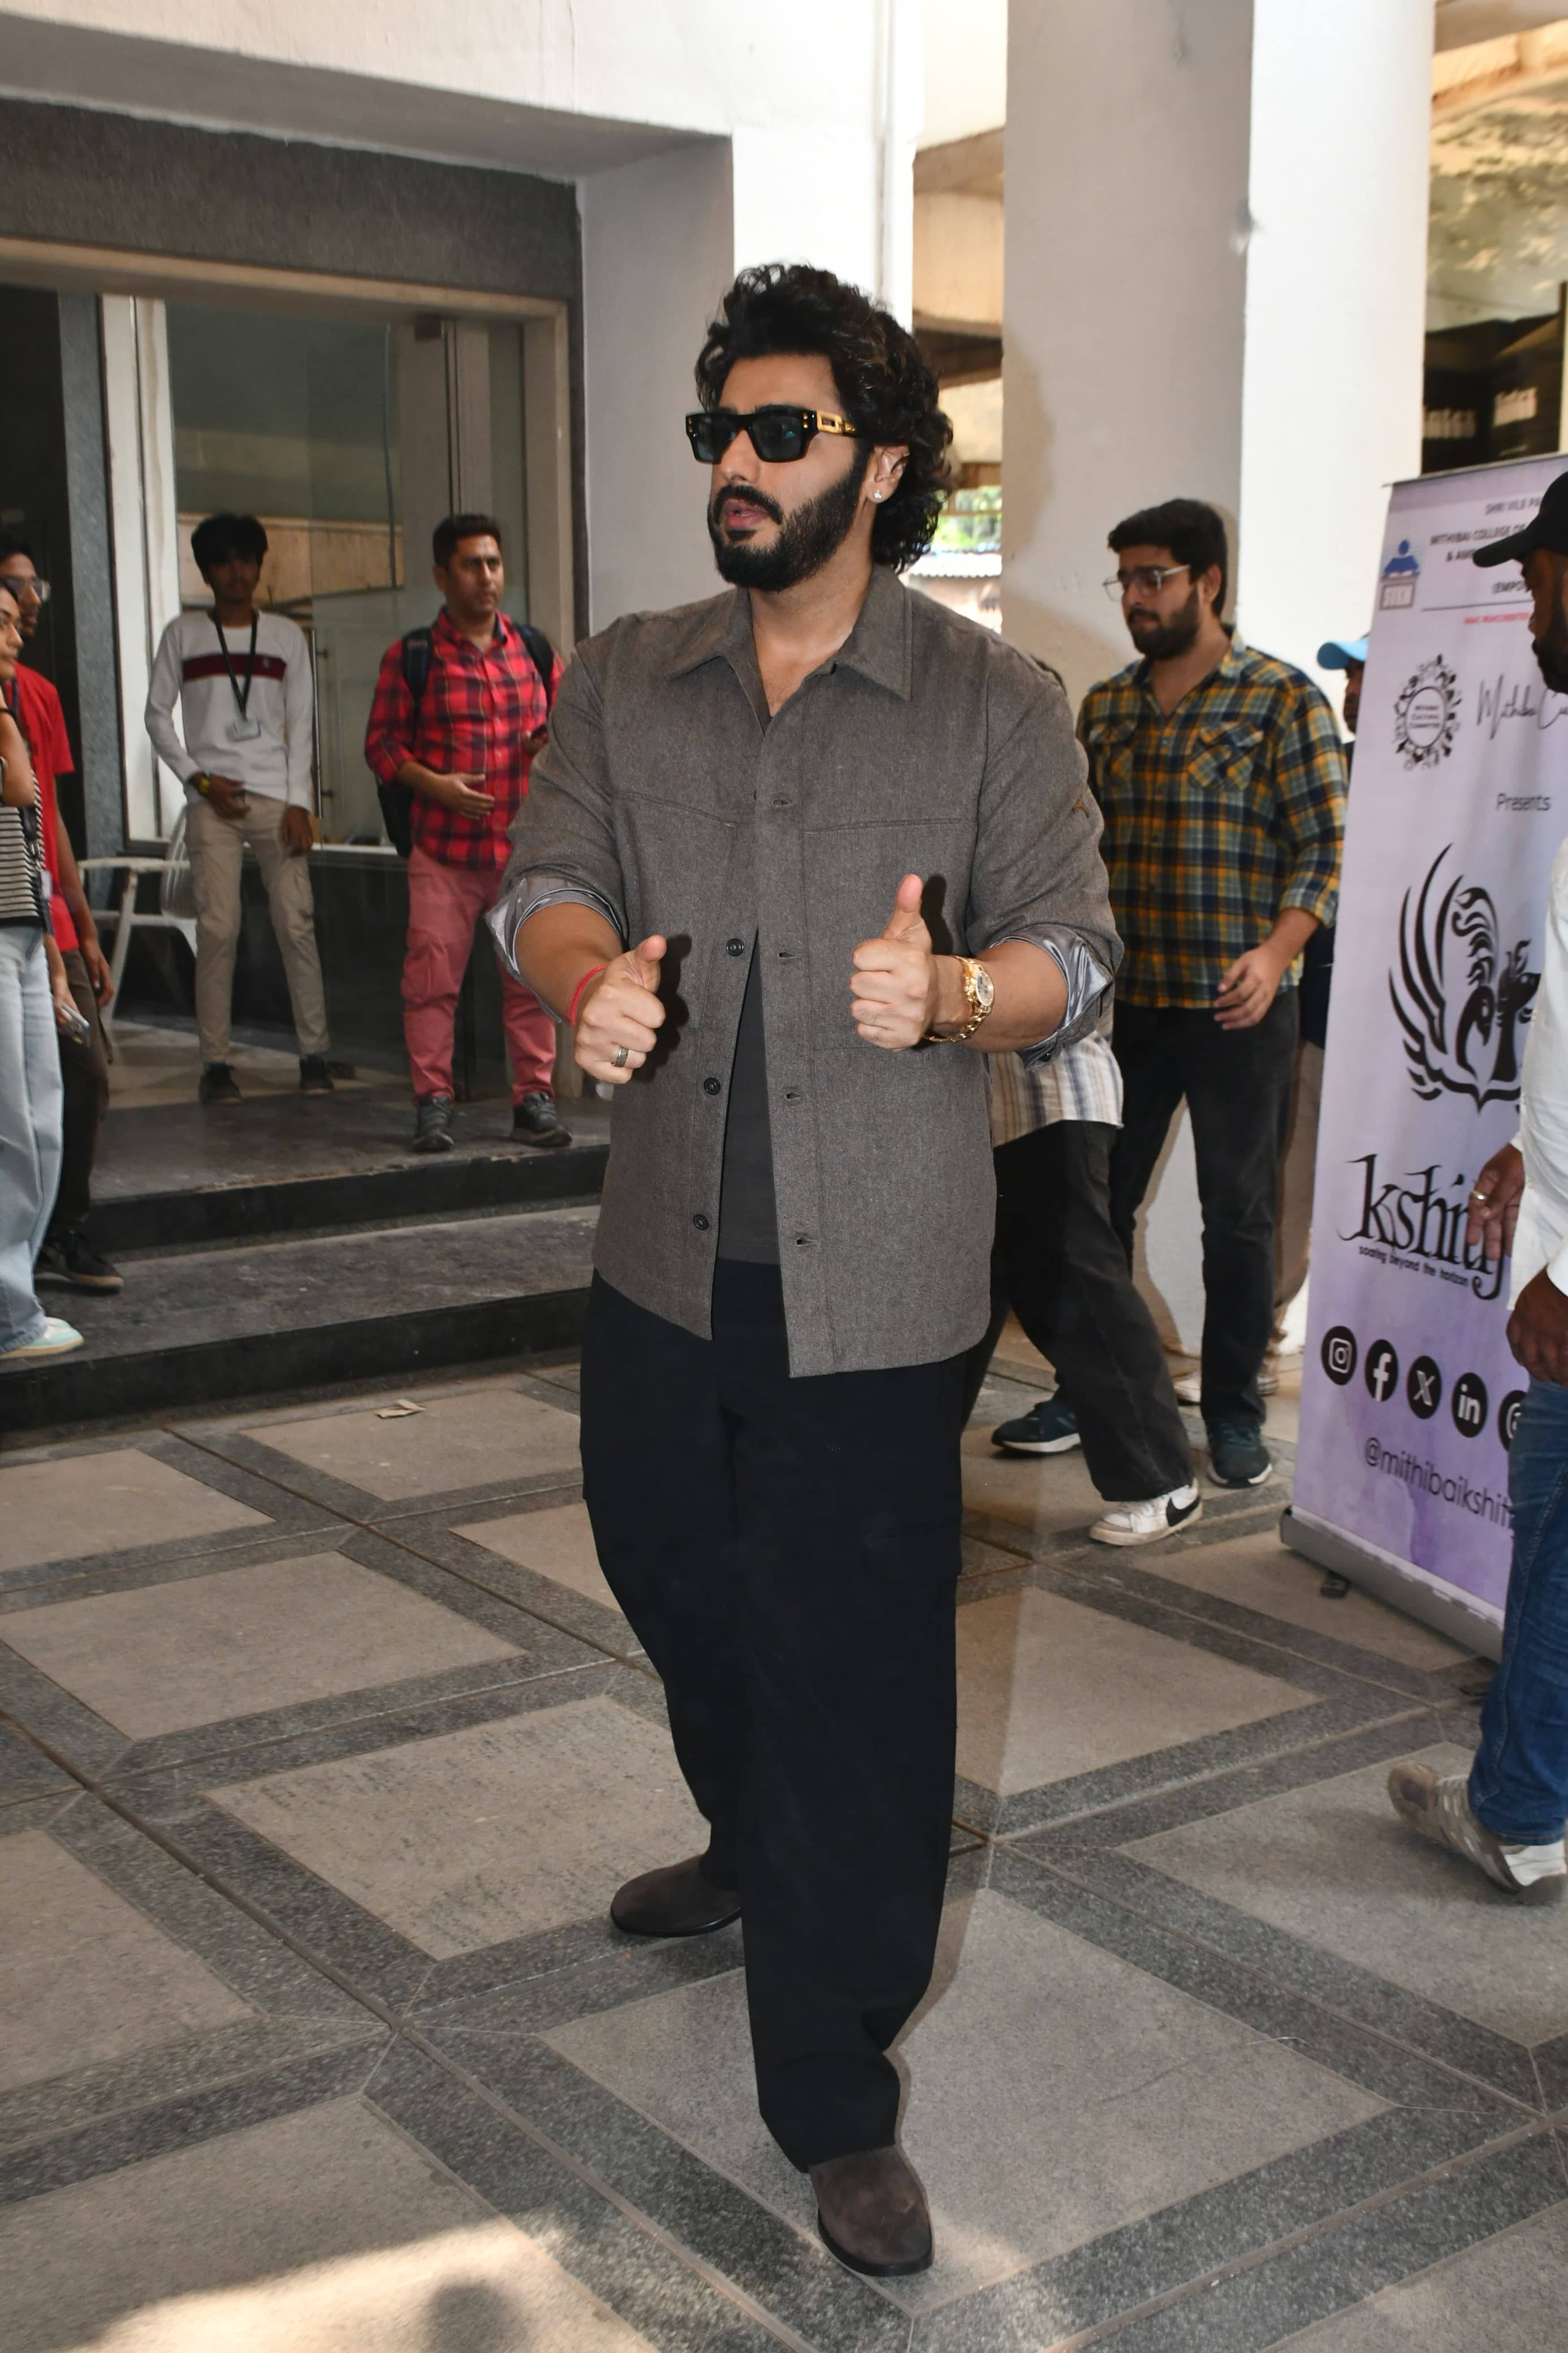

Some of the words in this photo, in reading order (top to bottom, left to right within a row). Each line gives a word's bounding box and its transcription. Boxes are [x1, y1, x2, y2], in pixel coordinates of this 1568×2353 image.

[1473, 525, 1510, 540] COLLEGE
[1496, 792, 1552, 812] Presents
[1423, 1262, 1436, 1276] the
[1364, 1437, 1509, 1528] @mithibaikshit
